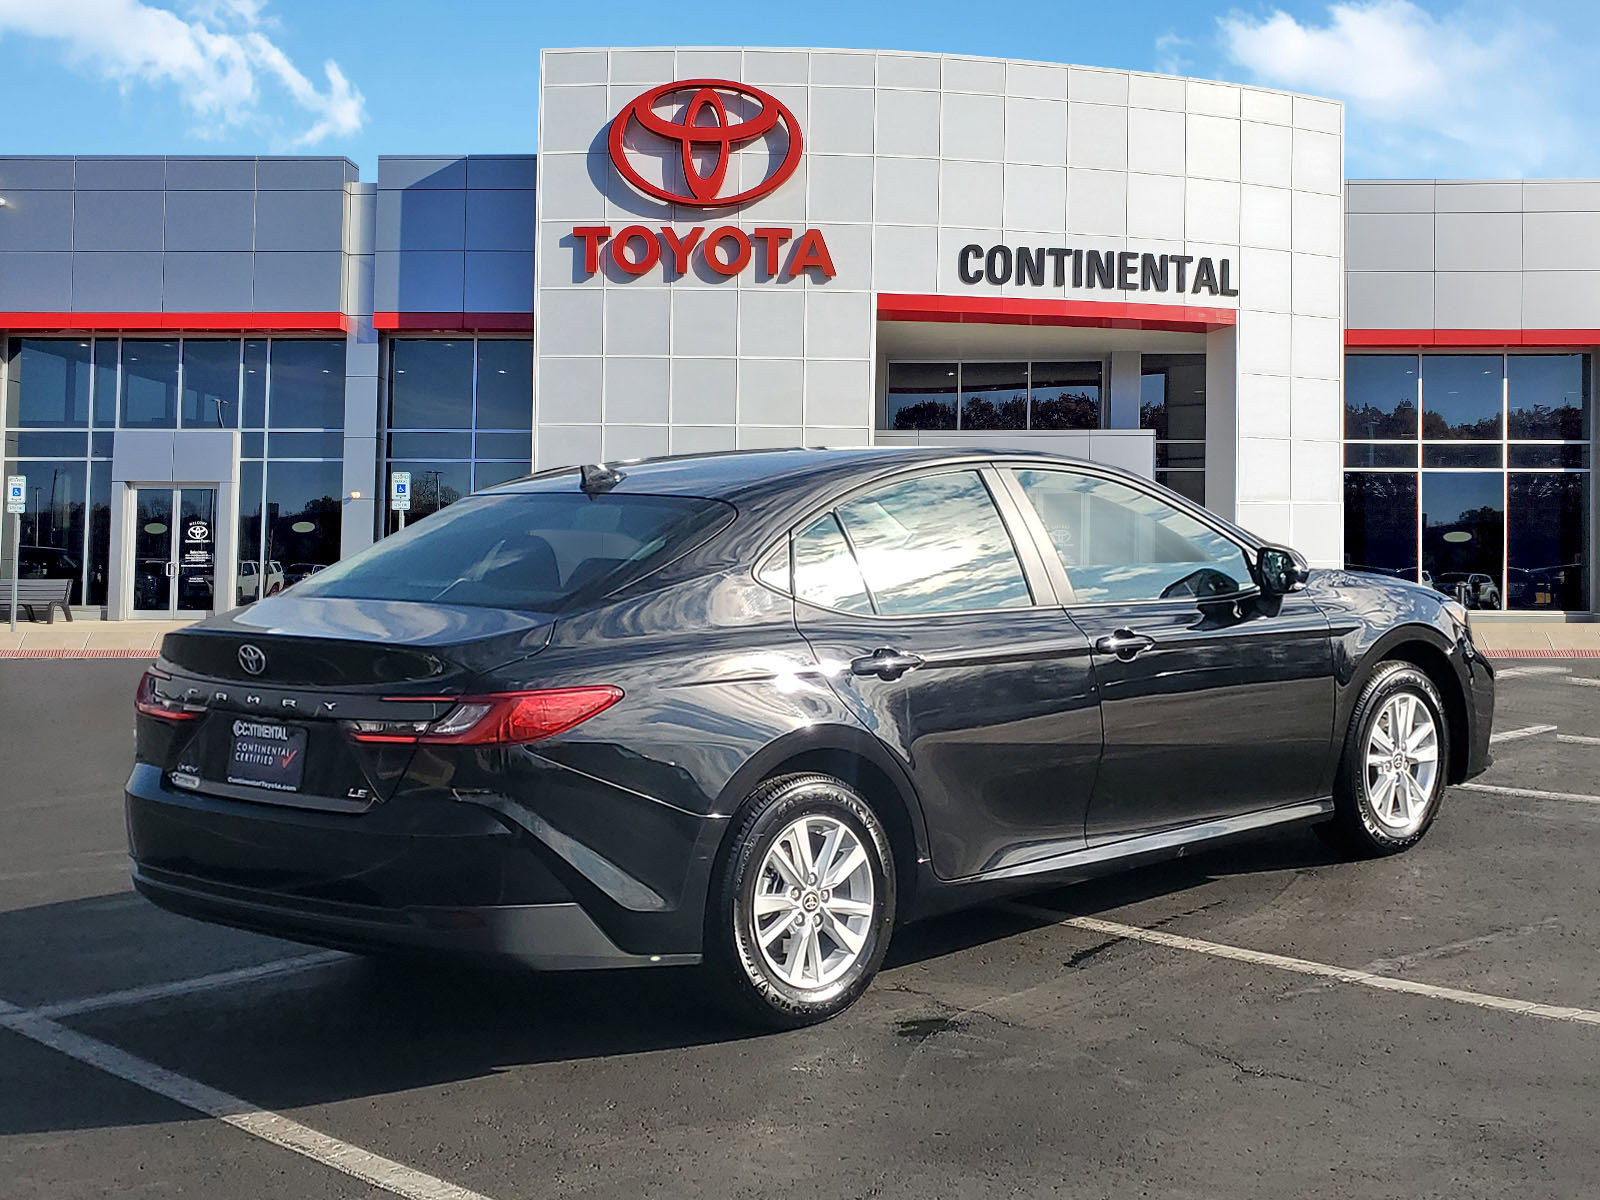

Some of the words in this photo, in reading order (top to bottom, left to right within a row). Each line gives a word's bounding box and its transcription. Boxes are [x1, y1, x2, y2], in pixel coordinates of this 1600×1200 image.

[572, 225, 837, 277] TOYOTA
[959, 244, 1239, 297] CONTINENTAL
[236, 742, 290, 758] CONTINENTAL
[235, 751, 274, 766] CERTIFIED
[347, 787, 368, 799] LE
